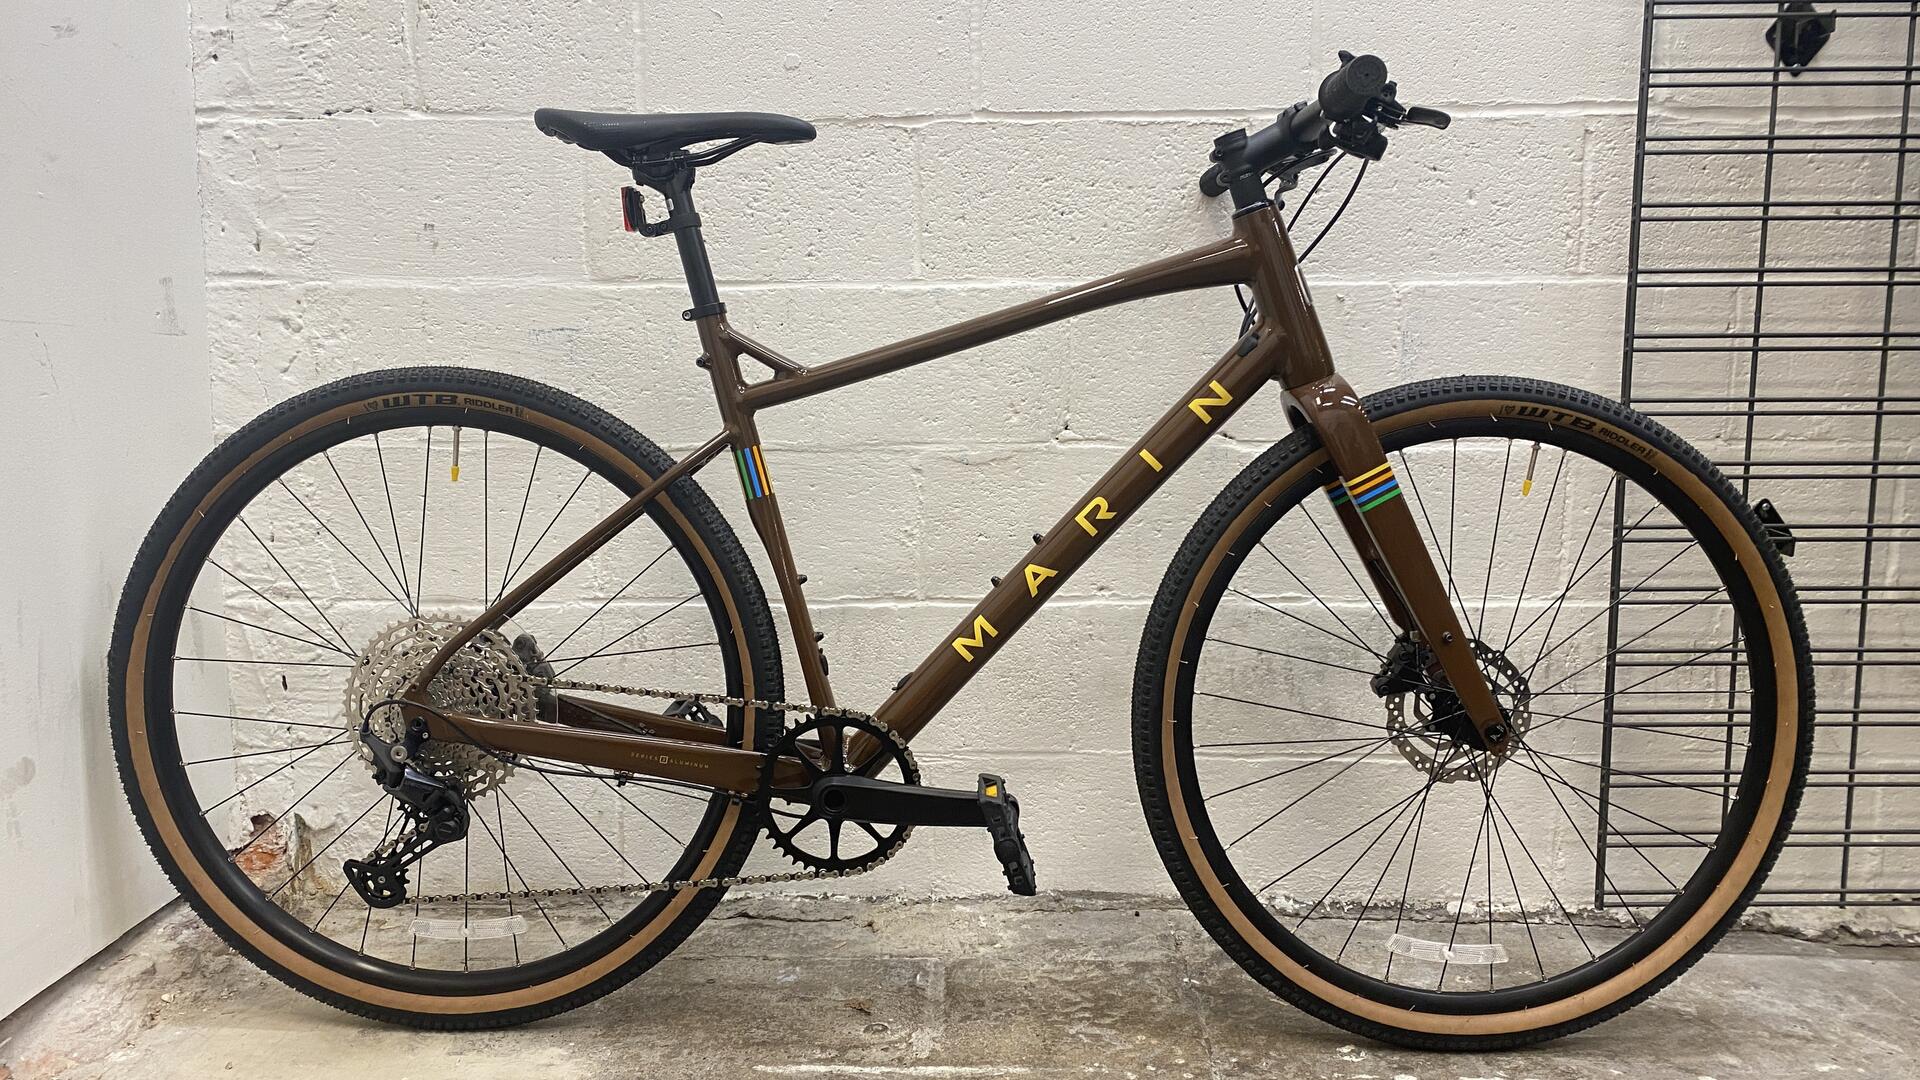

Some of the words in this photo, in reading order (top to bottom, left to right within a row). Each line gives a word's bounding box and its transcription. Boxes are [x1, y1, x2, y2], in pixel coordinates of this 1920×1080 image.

[382, 394, 458, 408] WTB
[464, 397, 513, 414] RIDDLER
[1516, 406, 1597, 430] WTB
[1600, 427, 1646, 455] RIDDLER
[952, 380, 1233, 662] MARIN
